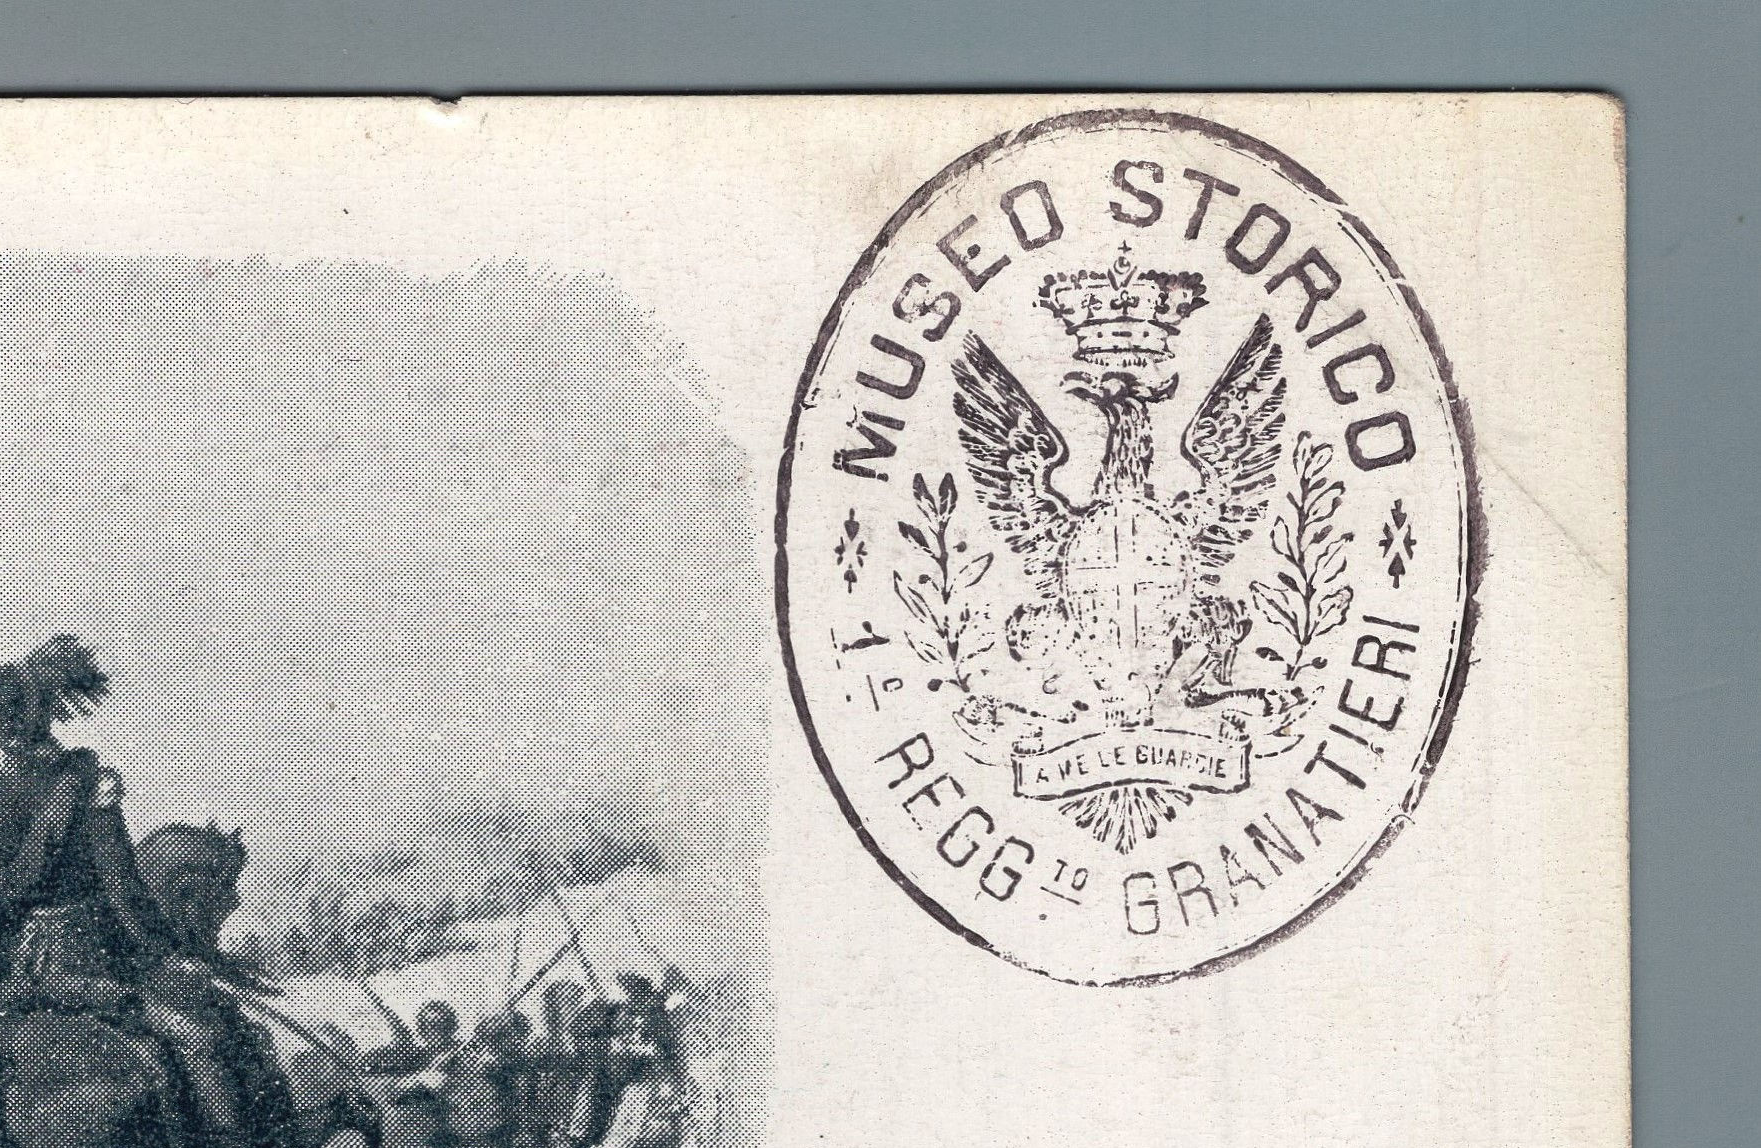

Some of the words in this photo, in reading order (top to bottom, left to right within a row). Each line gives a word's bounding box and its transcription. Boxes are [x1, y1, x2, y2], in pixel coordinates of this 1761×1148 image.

[833, 179, 1063, 482] MUSEO
[1108, 160, 1416, 473] STORICO
[1123, 615, 1420, 935] GRANATIERI
